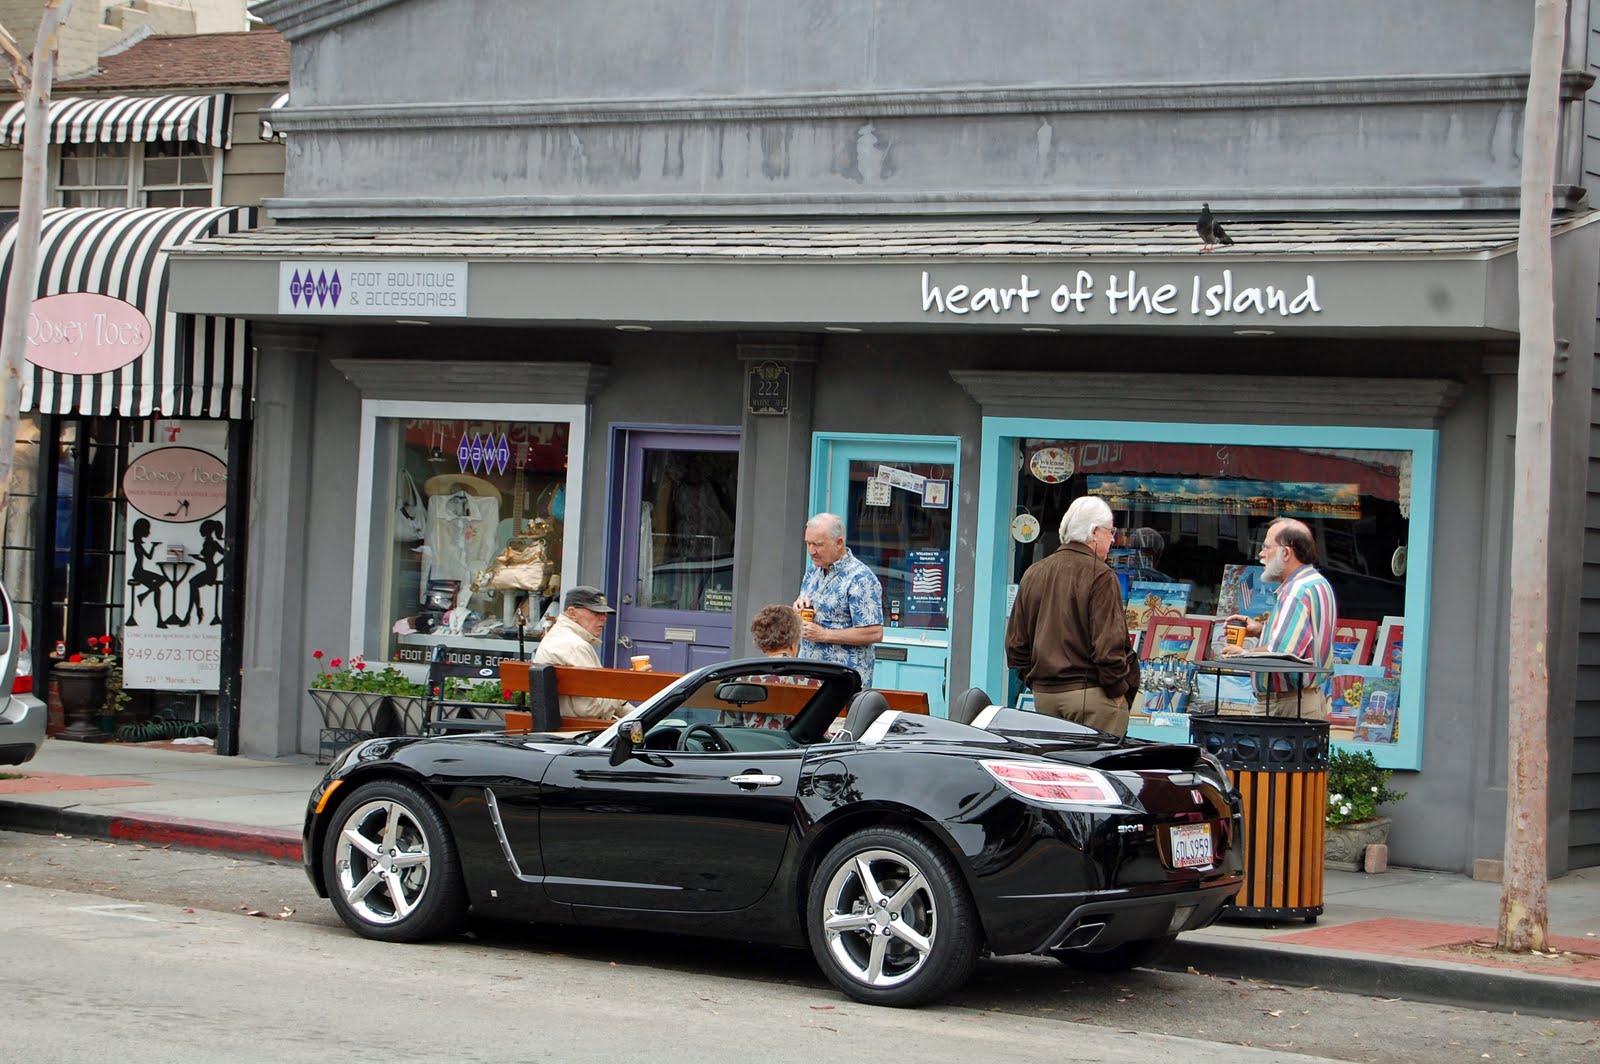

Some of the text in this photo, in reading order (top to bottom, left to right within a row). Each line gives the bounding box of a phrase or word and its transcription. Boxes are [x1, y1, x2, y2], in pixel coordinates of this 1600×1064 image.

[351, 272, 381, 287] FOOT
[350, 292, 360, 305] &
[921, 270, 1321, 317] heart of the Island
[93, 311, 144, 346] Toes
[758, 381, 779, 396] 222
[1040, 458, 1065, 466] Welcome
[133, 466, 228, 488] Rosey Toes
[127, 648, 220, 662] 949.673.TOES
[400, 649, 422, 661] FOOT
[474, 654, 482, 665] &
[1117, 824, 1137, 832] SKY
[1175, 838, 1208, 861] 6DLS959
